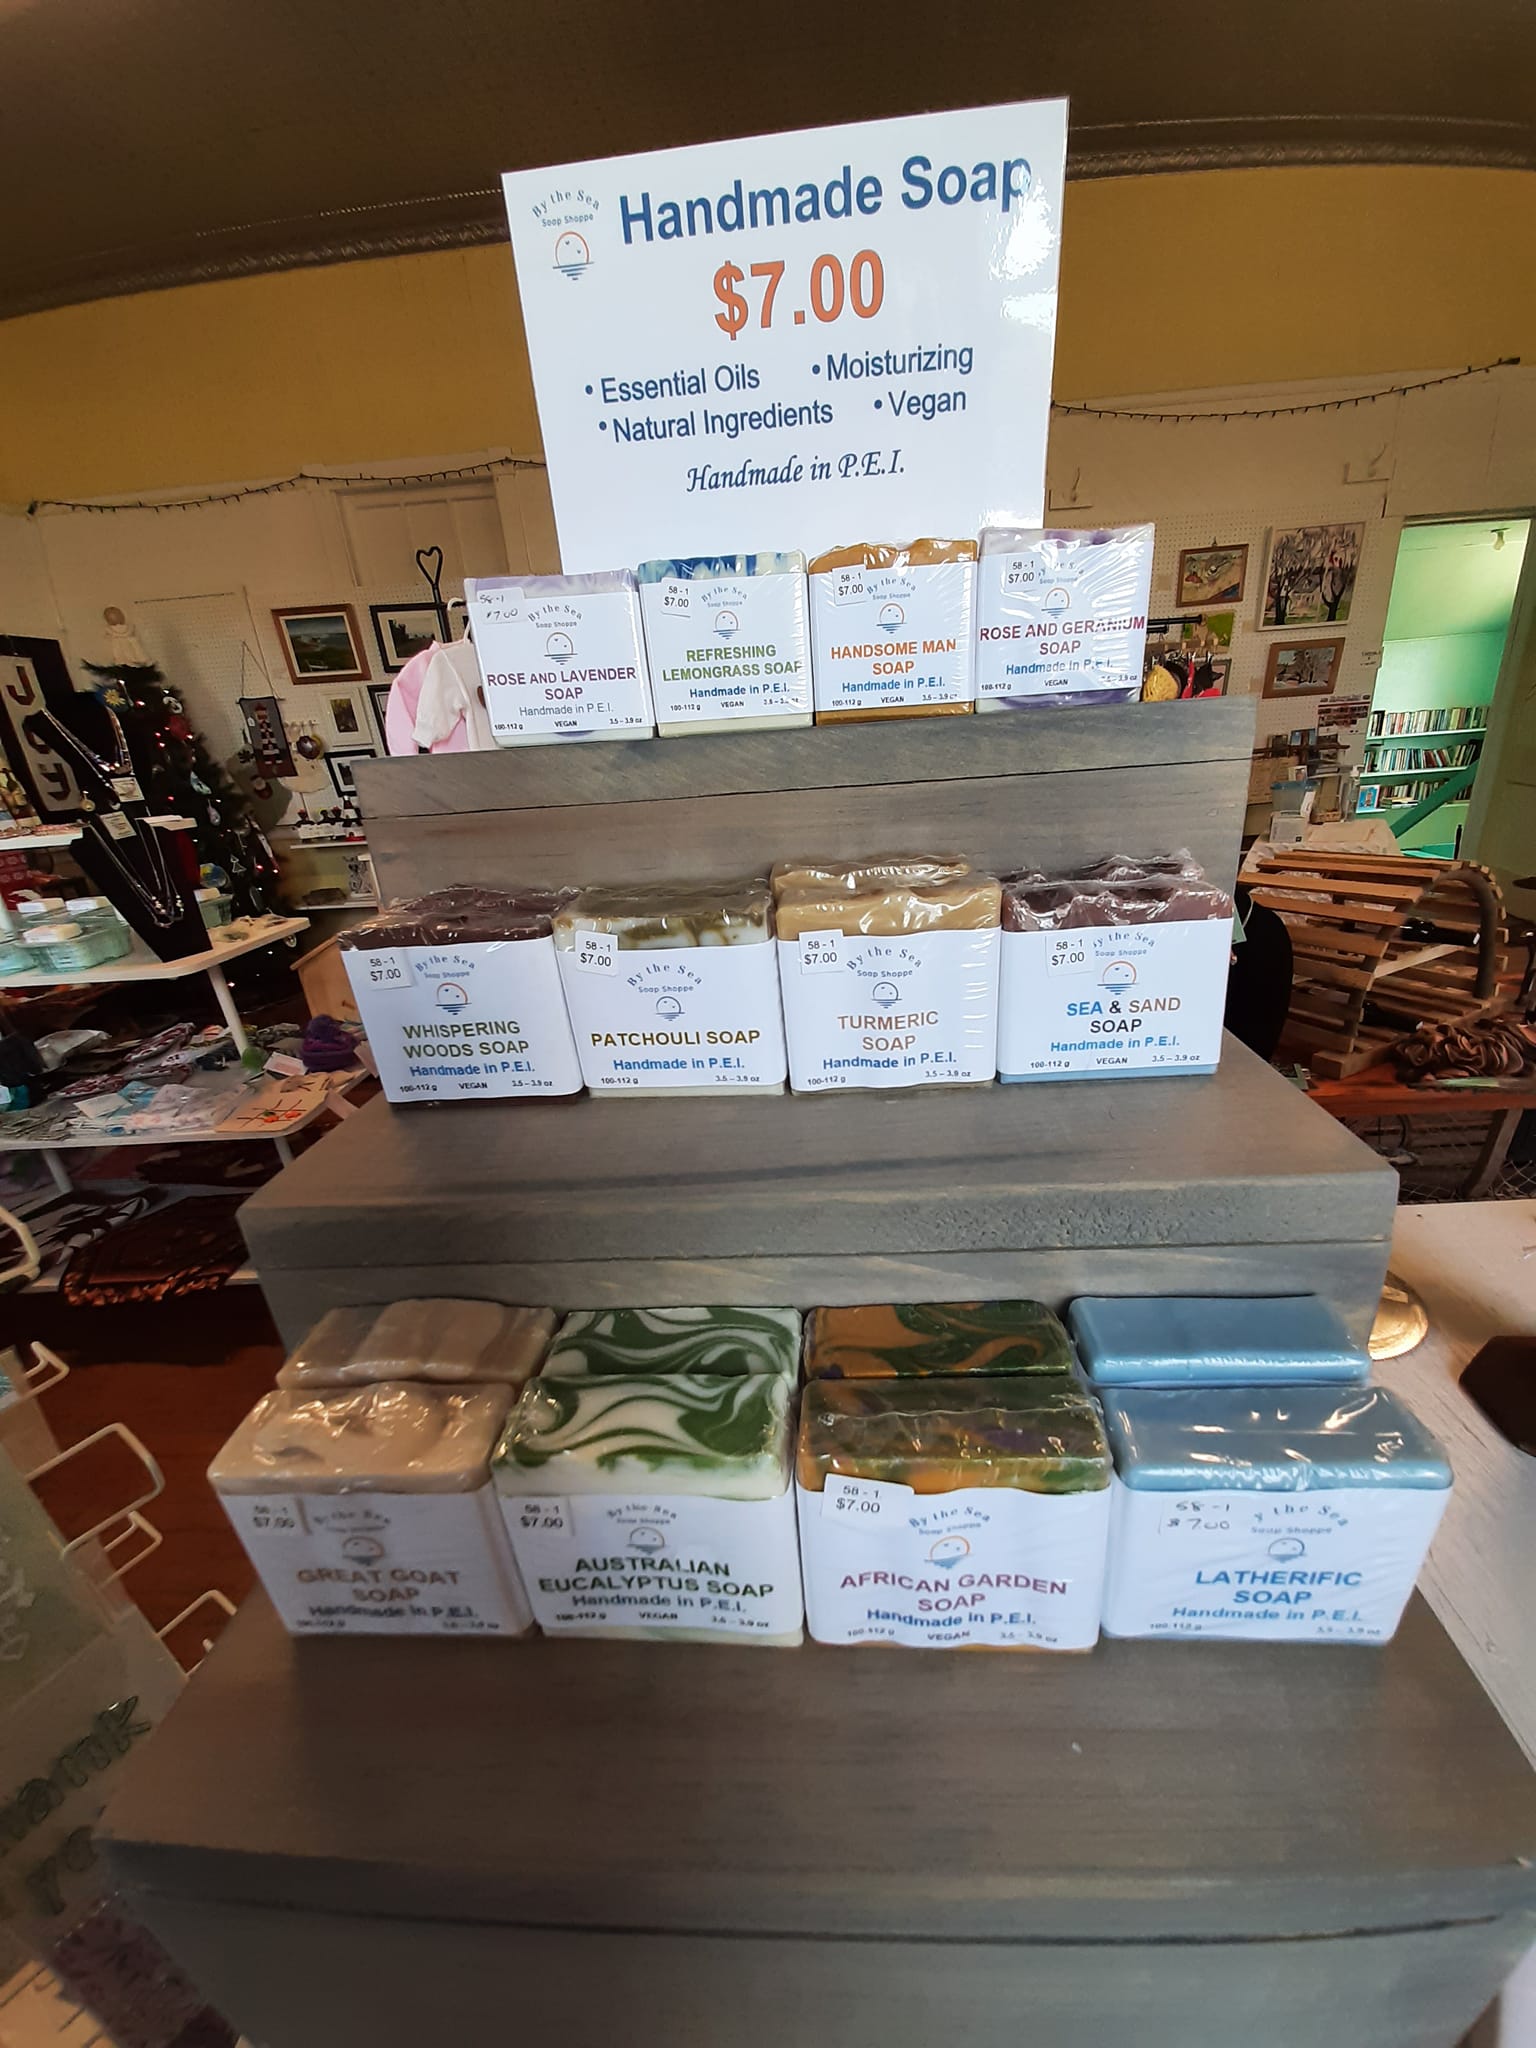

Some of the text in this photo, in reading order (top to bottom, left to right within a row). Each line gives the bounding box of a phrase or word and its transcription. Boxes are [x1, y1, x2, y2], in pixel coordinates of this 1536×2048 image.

[532, 190, 599, 218] By the Sea
[619, 155, 1032, 244] Handmade Soap
[542, 213, 593, 227] Soap Shoppe
[713, 249, 885, 341] $7.00
[826, 343, 974, 381] Moisturizing
[601, 365, 761, 404] Essential Oils
[888, 388, 967, 421] Vegan
[613, 400, 834, 444] Natural Ingredients
[686, 450, 905, 493] Handmade in P.E.I.
[841, 574, 850, 582] 58
[1008, 572, 1034, 583] $7.00
[669, 586, 678, 594] 58
[701, 586, 748, 602] By the Sea
[838, 584, 864, 596] $7.00
[866, 577, 916, 595] By the Sea
[664, 596, 689, 608] $7.00
[528, 605, 583, 622] By the Sea
[980, 626, 1021, 641] ROSE
[1025, 623, 1057, 637] AND
[686, 645, 776, 662] REFRESHING
[831, 639, 956, 659] HANDSOME MAN
[1040, 641, 1081, 655] SOAP
[663, 664, 760, 681] LEMONGRASS
[872, 661, 914, 675] SOAP
[1006, 662, 1065, 675] Handmade
[487, 667, 636, 686] ROSE AND LAVENDER
[842, 677, 945, 692] Handmade in P.E.I.
[545, 687, 583, 700] SOAP
[690, 683, 790, 698] Handmade in P.E.I.
[881, 696, 904, 704] VEGAN
[519, 703, 613, 716] Handmade in P.E.I.
[585, 941, 597, 950] 58
[607, 944, 611, 952] 1
[807, 940, 820, 950] 58
[831, 940, 835, 948] 1
[1056, 941, 1068, 950] 58
[1079, 939, 1083, 947] 1
[370, 958, 382, 967] 58
[390, 957, 395, 965] 1
[415, 955, 476, 972] By the Sea
[580, 953, 612, 967] $7.00
[804, 952, 838, 965] $7.00
[846, 946, 922, 970] By the Sea
[1051, 951, 1084, 966] $7.00
[370, 968, 401, 982] $7.00
[627, 963, 702, 987] By the Sea
[857, 970, 913, 978] Soap Shoppe
[662, 984, 694, 993] Shoppe
[1066, 997, 1181, 1016] SEA & SAND
[838, 1011, 938, 1030] TURMERIC
[1090, 1019, 1142, 1033] SOAP
[402, 1021, 520, 1040] WHISPERING
[591, 1030, 761, 1047] PATCHOULI SOAP
[403, 1040, 529, 1059] WOODS SOAP
[862, 1035, 916, 1051] SOAP
[1051, 1036, 1180, 1052] Handmade in P.E.I.
[410, 1061, 535, 1077] Handmade in P.E.I.
[614, 1058, 745, 1070] Handmade in P.E.I.
[823, 1052, 956, 1070] Handmade in P.E.I.
[1096, 1057, 1128, 1065] VEGAN
[459, 1082, 488, 1090] VEGAN
[842, 1486, 860, 1496] 58
[873, 1489, 880, 1498] 1
[836, 1498, 881, 1514] $7.00
[520, 1516, 563, 1528] $7.00
[575, 1556, 730, 1576] AUSTRALIAN
[297, 1568, 460, 1584] GREAT GOAT
[840, 1571, 1067, 1594] AFRICAN GARDEN
[1196, 1571, 1362, 1586] LATHERIFIC
[538, 1575, 774, 1598] EUCALYPTUS SOAP
[352, 1588, 420, 1602] SOAP
[572, 1594, 747, 1612] Handmade in P.E.I.
[918, 1593, 986, 1612] SOAP
[1233, 1590, 1313, 1604] SOAP
[867, 1608, 1036, 1627] Handmade in P.E.I.
[1172, 1607, 1362, 1621] Handmade in P.E.I.
